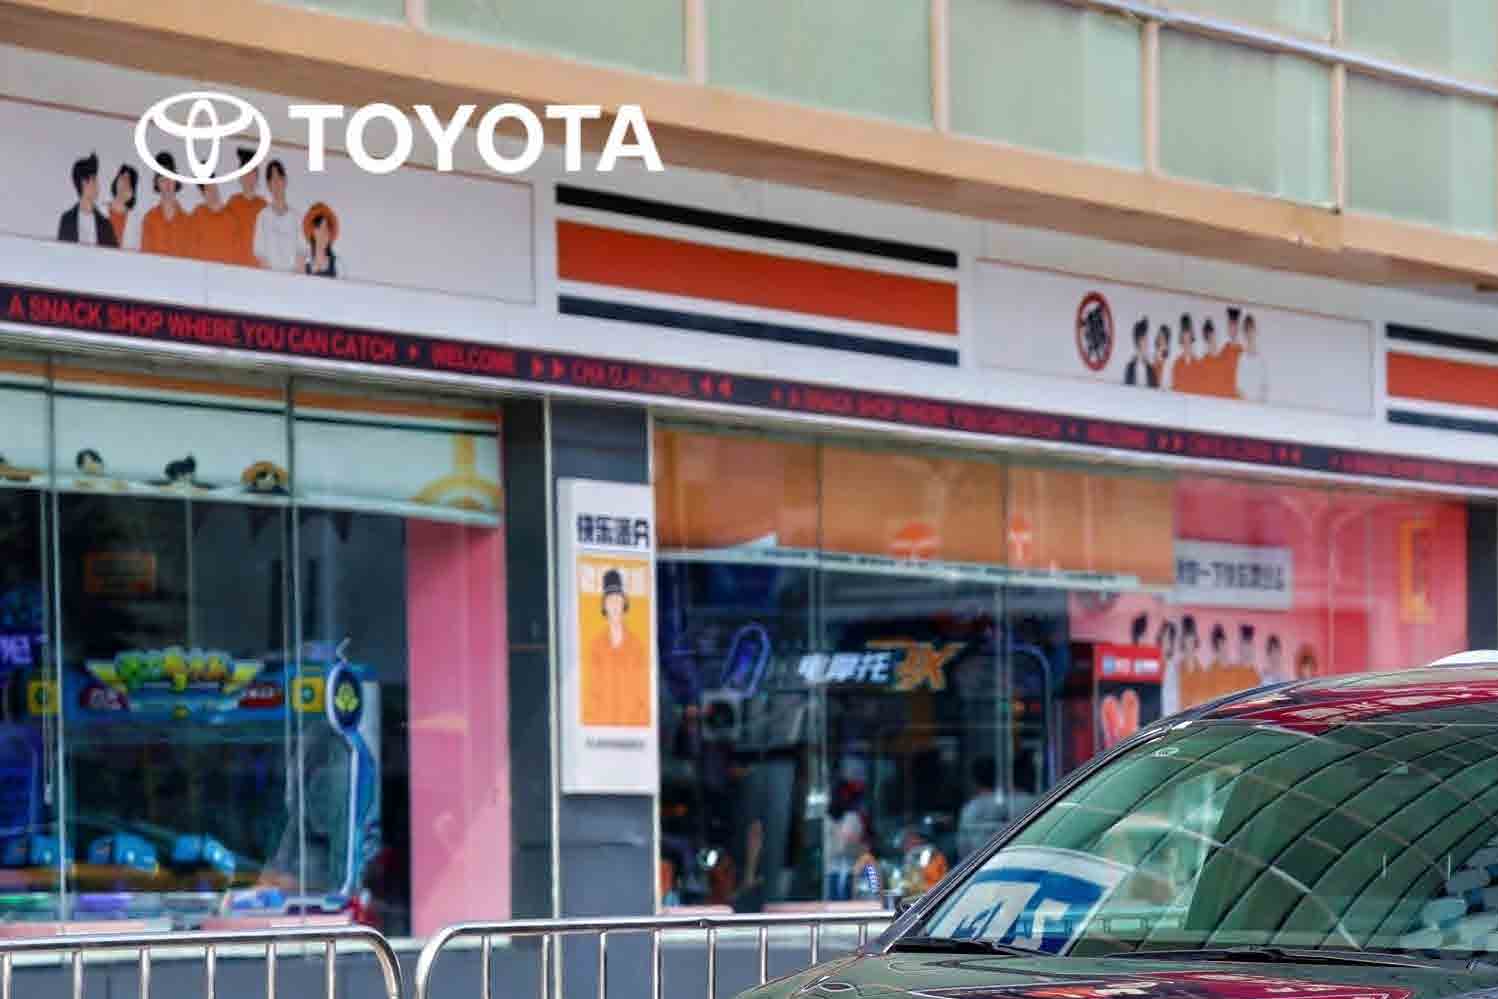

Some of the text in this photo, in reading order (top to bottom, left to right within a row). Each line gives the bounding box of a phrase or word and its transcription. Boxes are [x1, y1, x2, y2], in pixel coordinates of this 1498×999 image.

[9, 292, 24, 320] A
[29, 293, 100, 328] SNACK
[108, 303, 163, 334] SHOP
[168, 311, 236, 344] WHERE
[242, 320, 282, 350] YOU
[288, 325, 329, 354] CAN
[332, 331, 396, 362] CATCH
